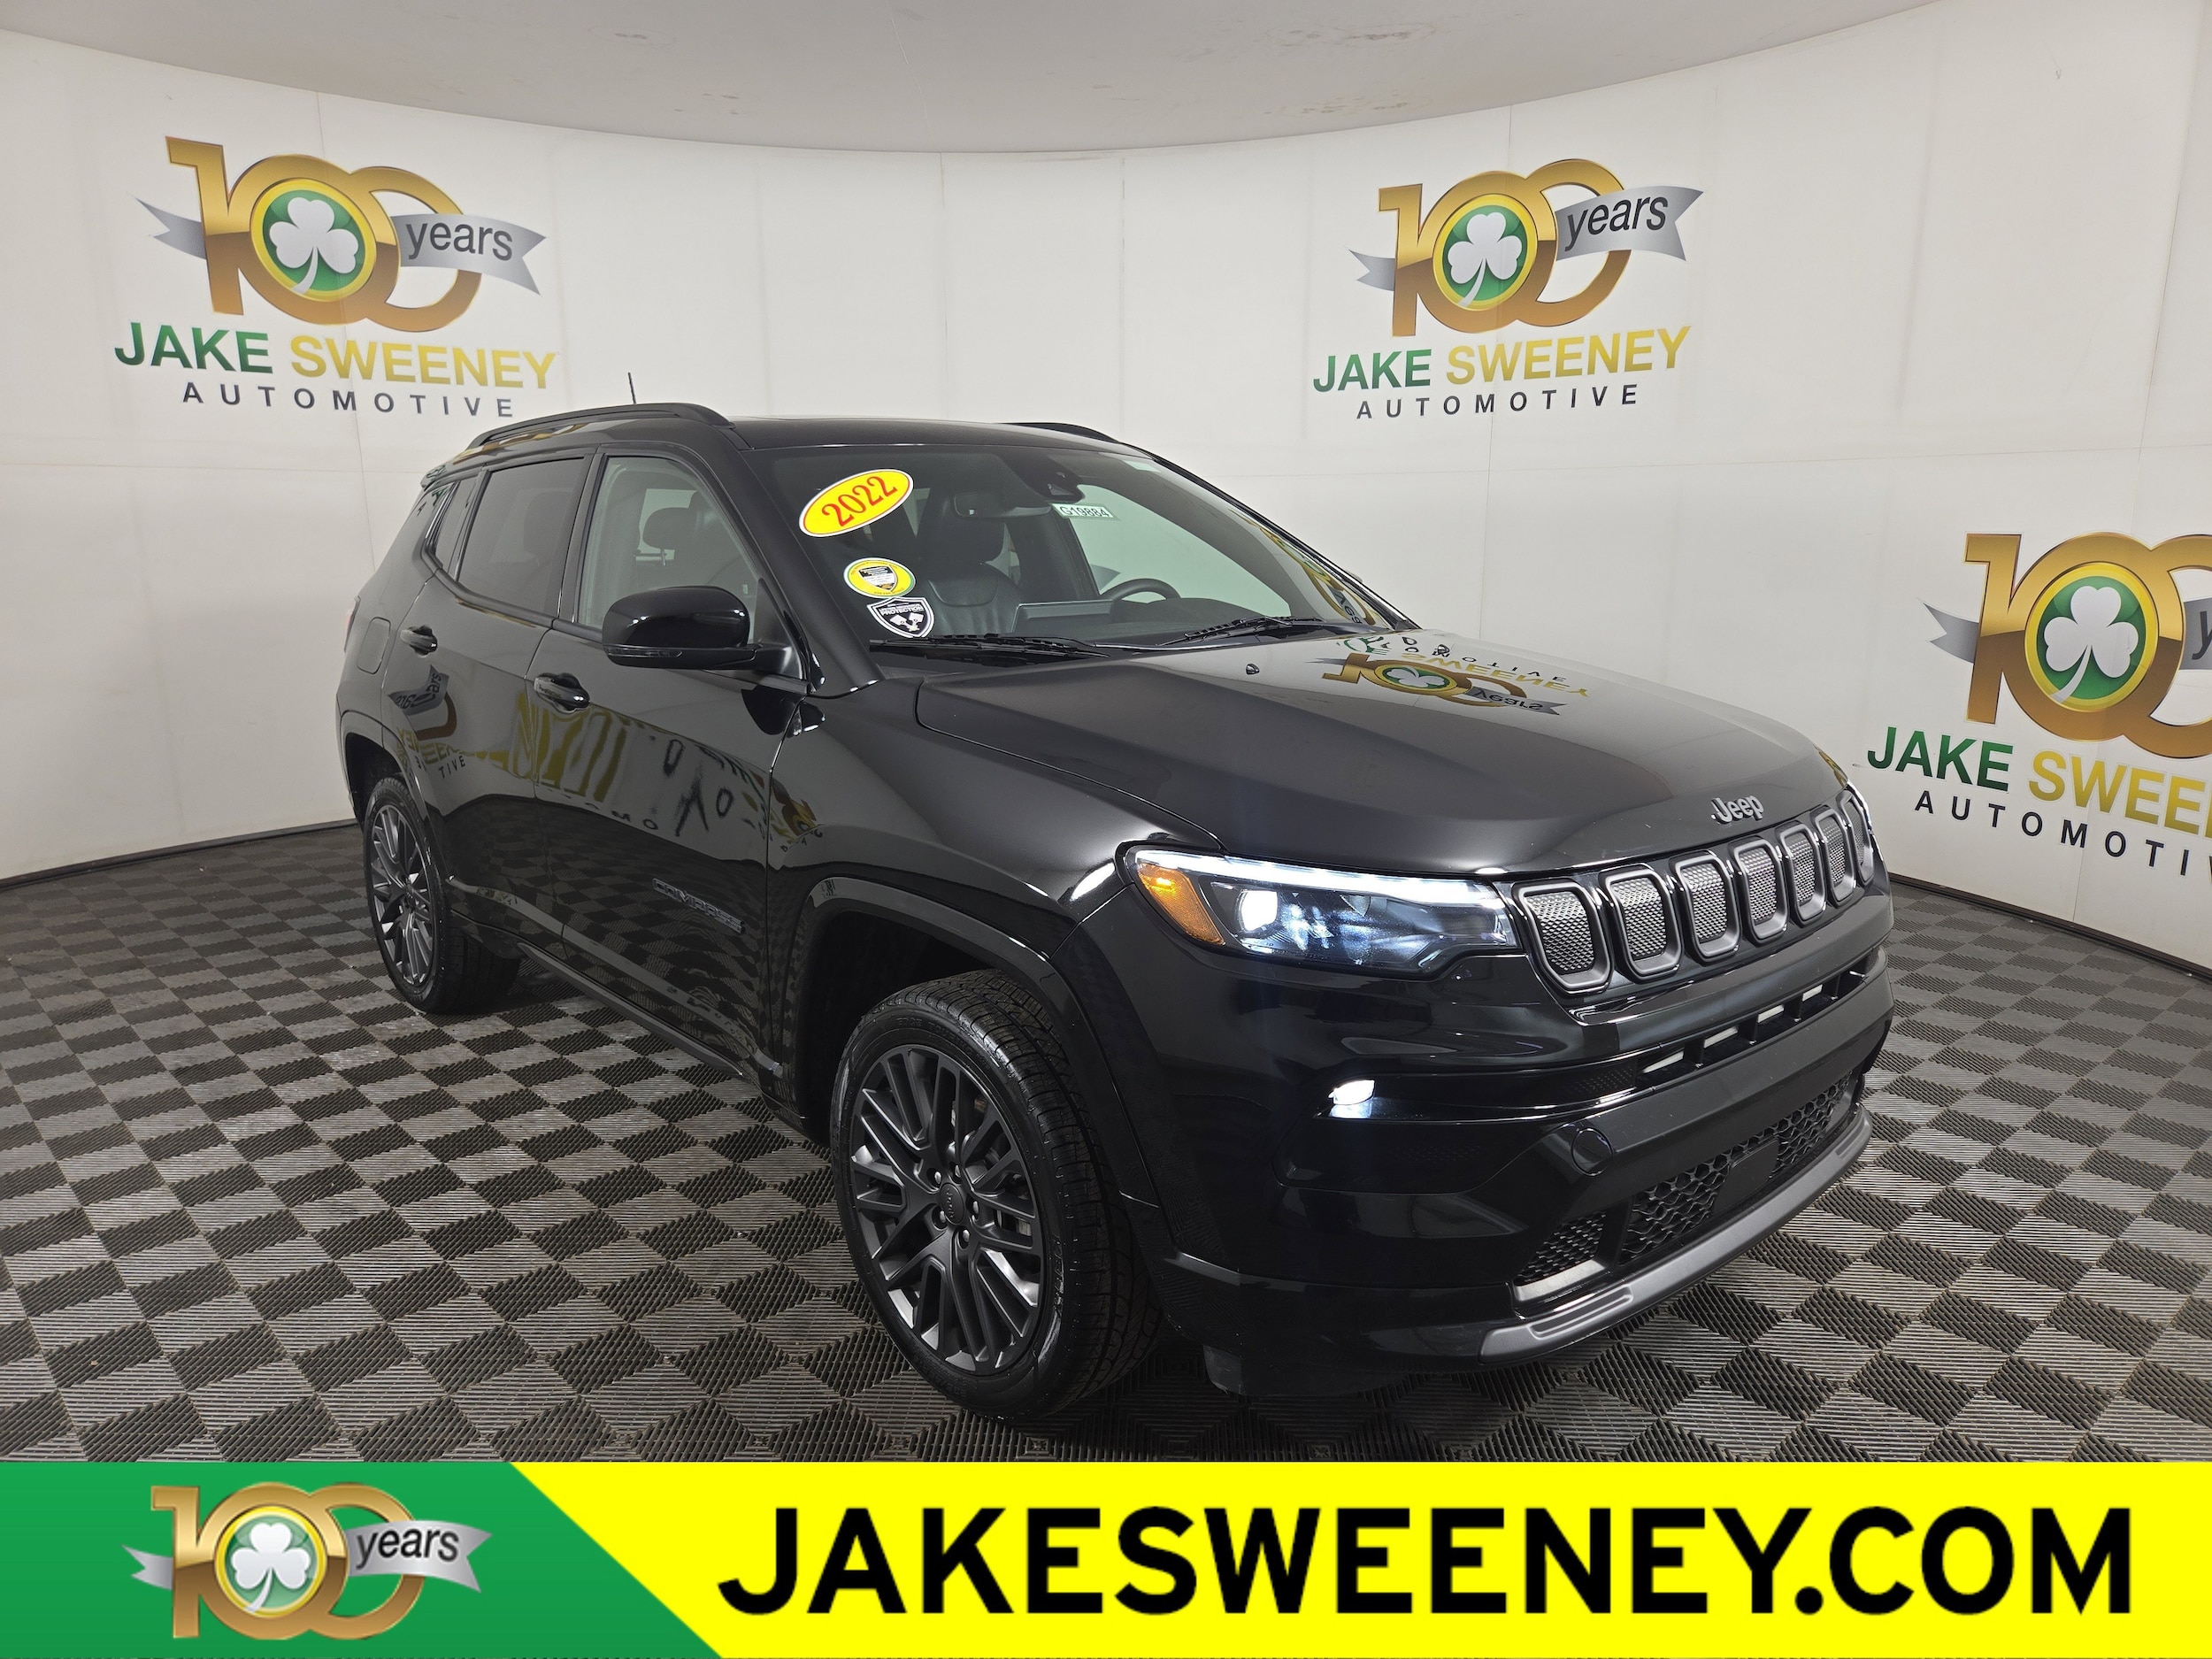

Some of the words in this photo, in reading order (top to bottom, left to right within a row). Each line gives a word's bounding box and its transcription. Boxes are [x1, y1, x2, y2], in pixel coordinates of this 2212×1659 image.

[405, 221, 514, 261] years
[1563, 195, 1669, 251] years
[114, 321, 273, 374] JAKE
[290, 334, 561, 389] SWEENEY
[1313, 349, 1432, 393] JAKE
[1446, 326, 1691, 385] SWEENEY
[182, 381, 513, 418] AUTOMOTIVE
[1356, 383, 1638, 419] AUTOMOTIVE
[820, 475, 898, 526] 2022
[1711, 795, 1764, 825] Jeep
[1867, 726, 2014, 792] JAKE
[2028, 750, 2212, 841] SWEE
[1915, 790, 2212, 880] AUTOMOTI
